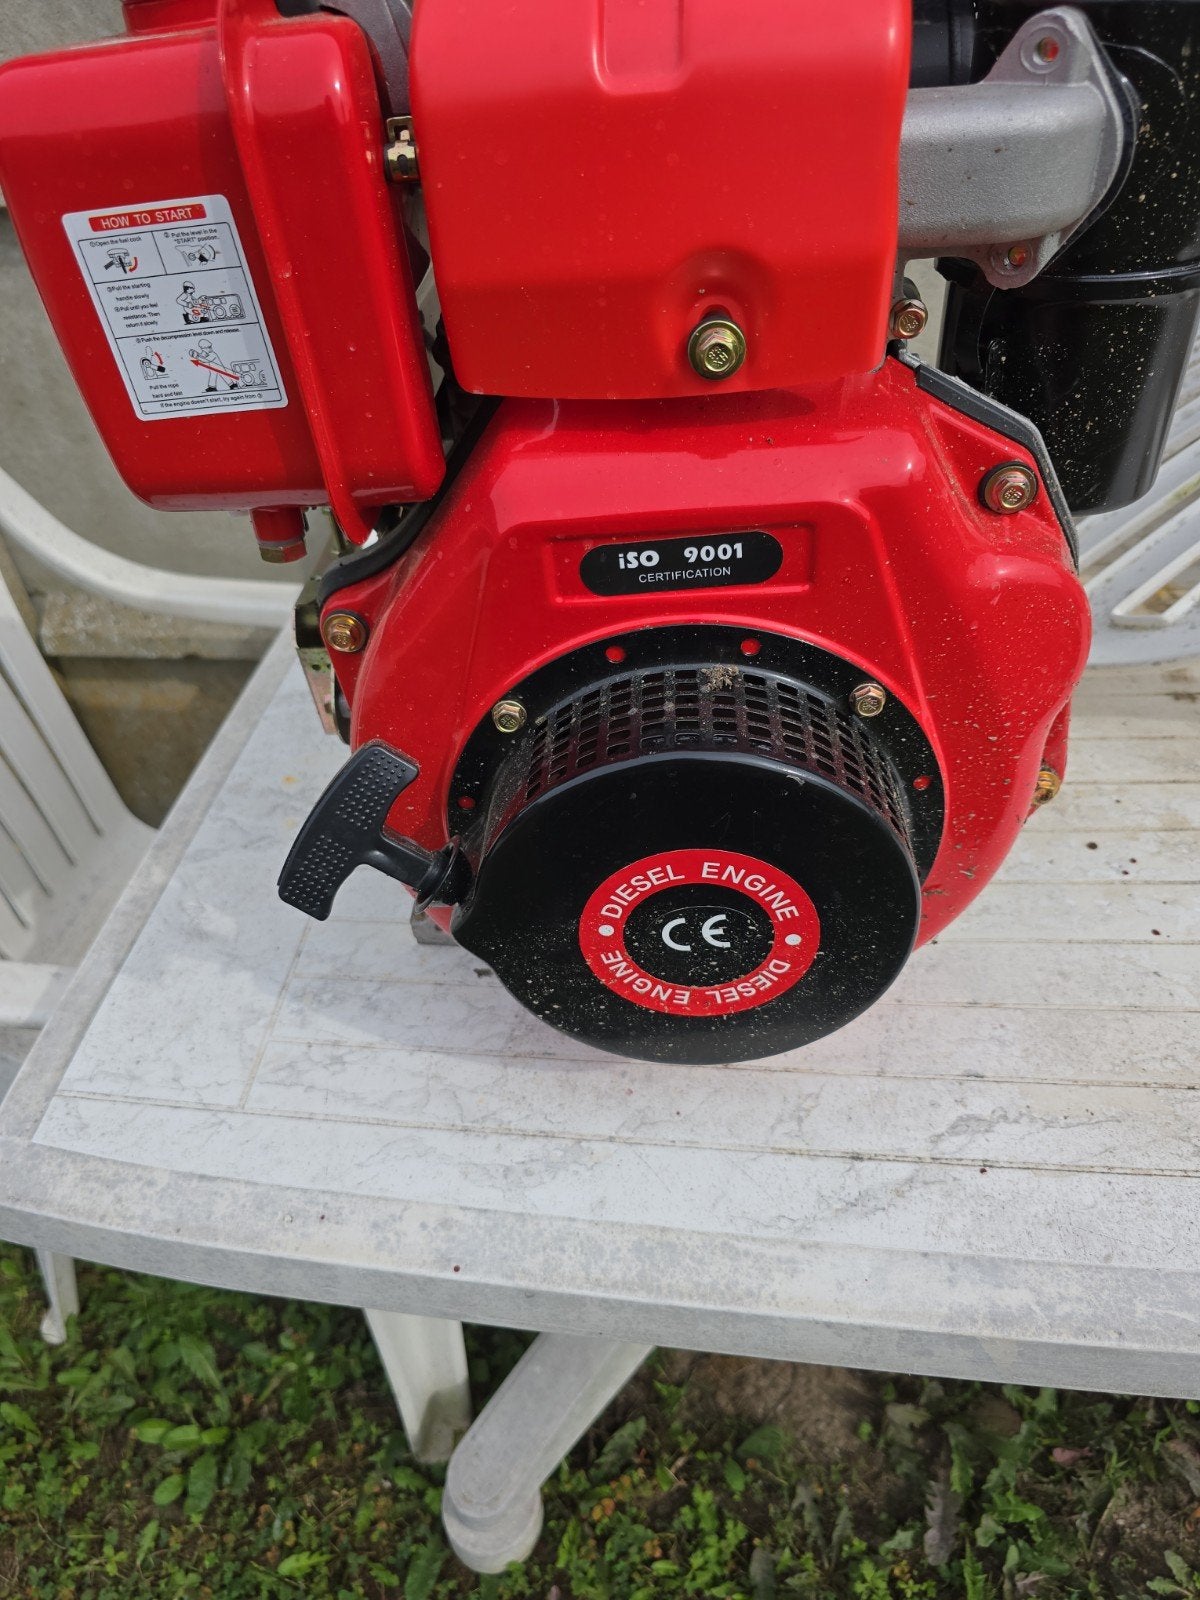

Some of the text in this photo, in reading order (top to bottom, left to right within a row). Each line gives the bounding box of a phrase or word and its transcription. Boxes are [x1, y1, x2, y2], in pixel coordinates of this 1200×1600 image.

[101, 207, 192, 229] HOW TO START
[683, 542, 743, 564] 9001
[638, 566, 731, 583] CERTIFICATION
[601, 861, 800, 922] DIESEL ENGINE
[661, 913, 731, 951] CE
[600, 950, 792, 1005] DIESEL ENGINE
